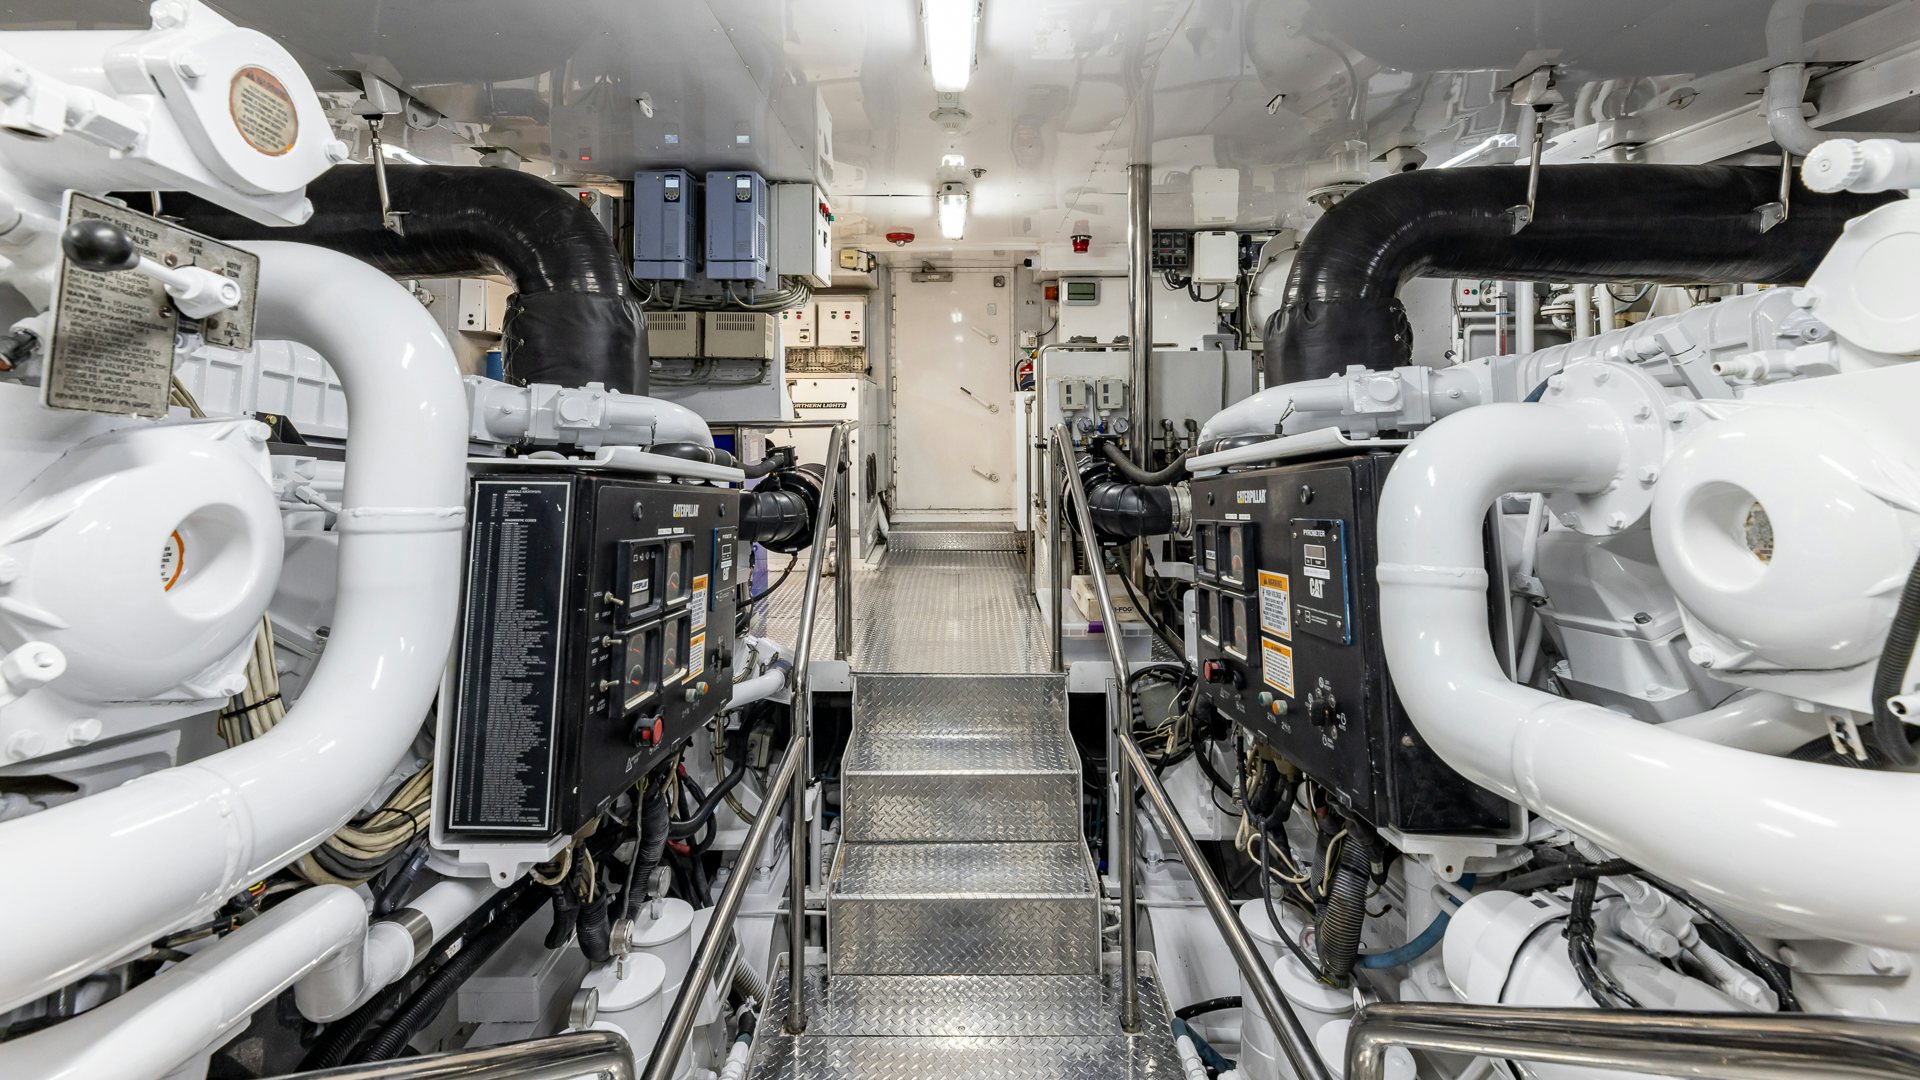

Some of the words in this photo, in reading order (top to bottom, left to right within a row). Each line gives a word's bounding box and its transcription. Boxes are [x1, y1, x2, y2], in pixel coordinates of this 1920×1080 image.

[135, 227, 159, 240] FILTER
[132, 235, 149, 247] ALVE
[1237, 490, 1266, 503] CATERPILLAR
[673, 504, 699, 517] CATERPILLAR
[1303, 529, 1326, 537] PYROMETER
[1310, 578, 1323, 598] CAT
